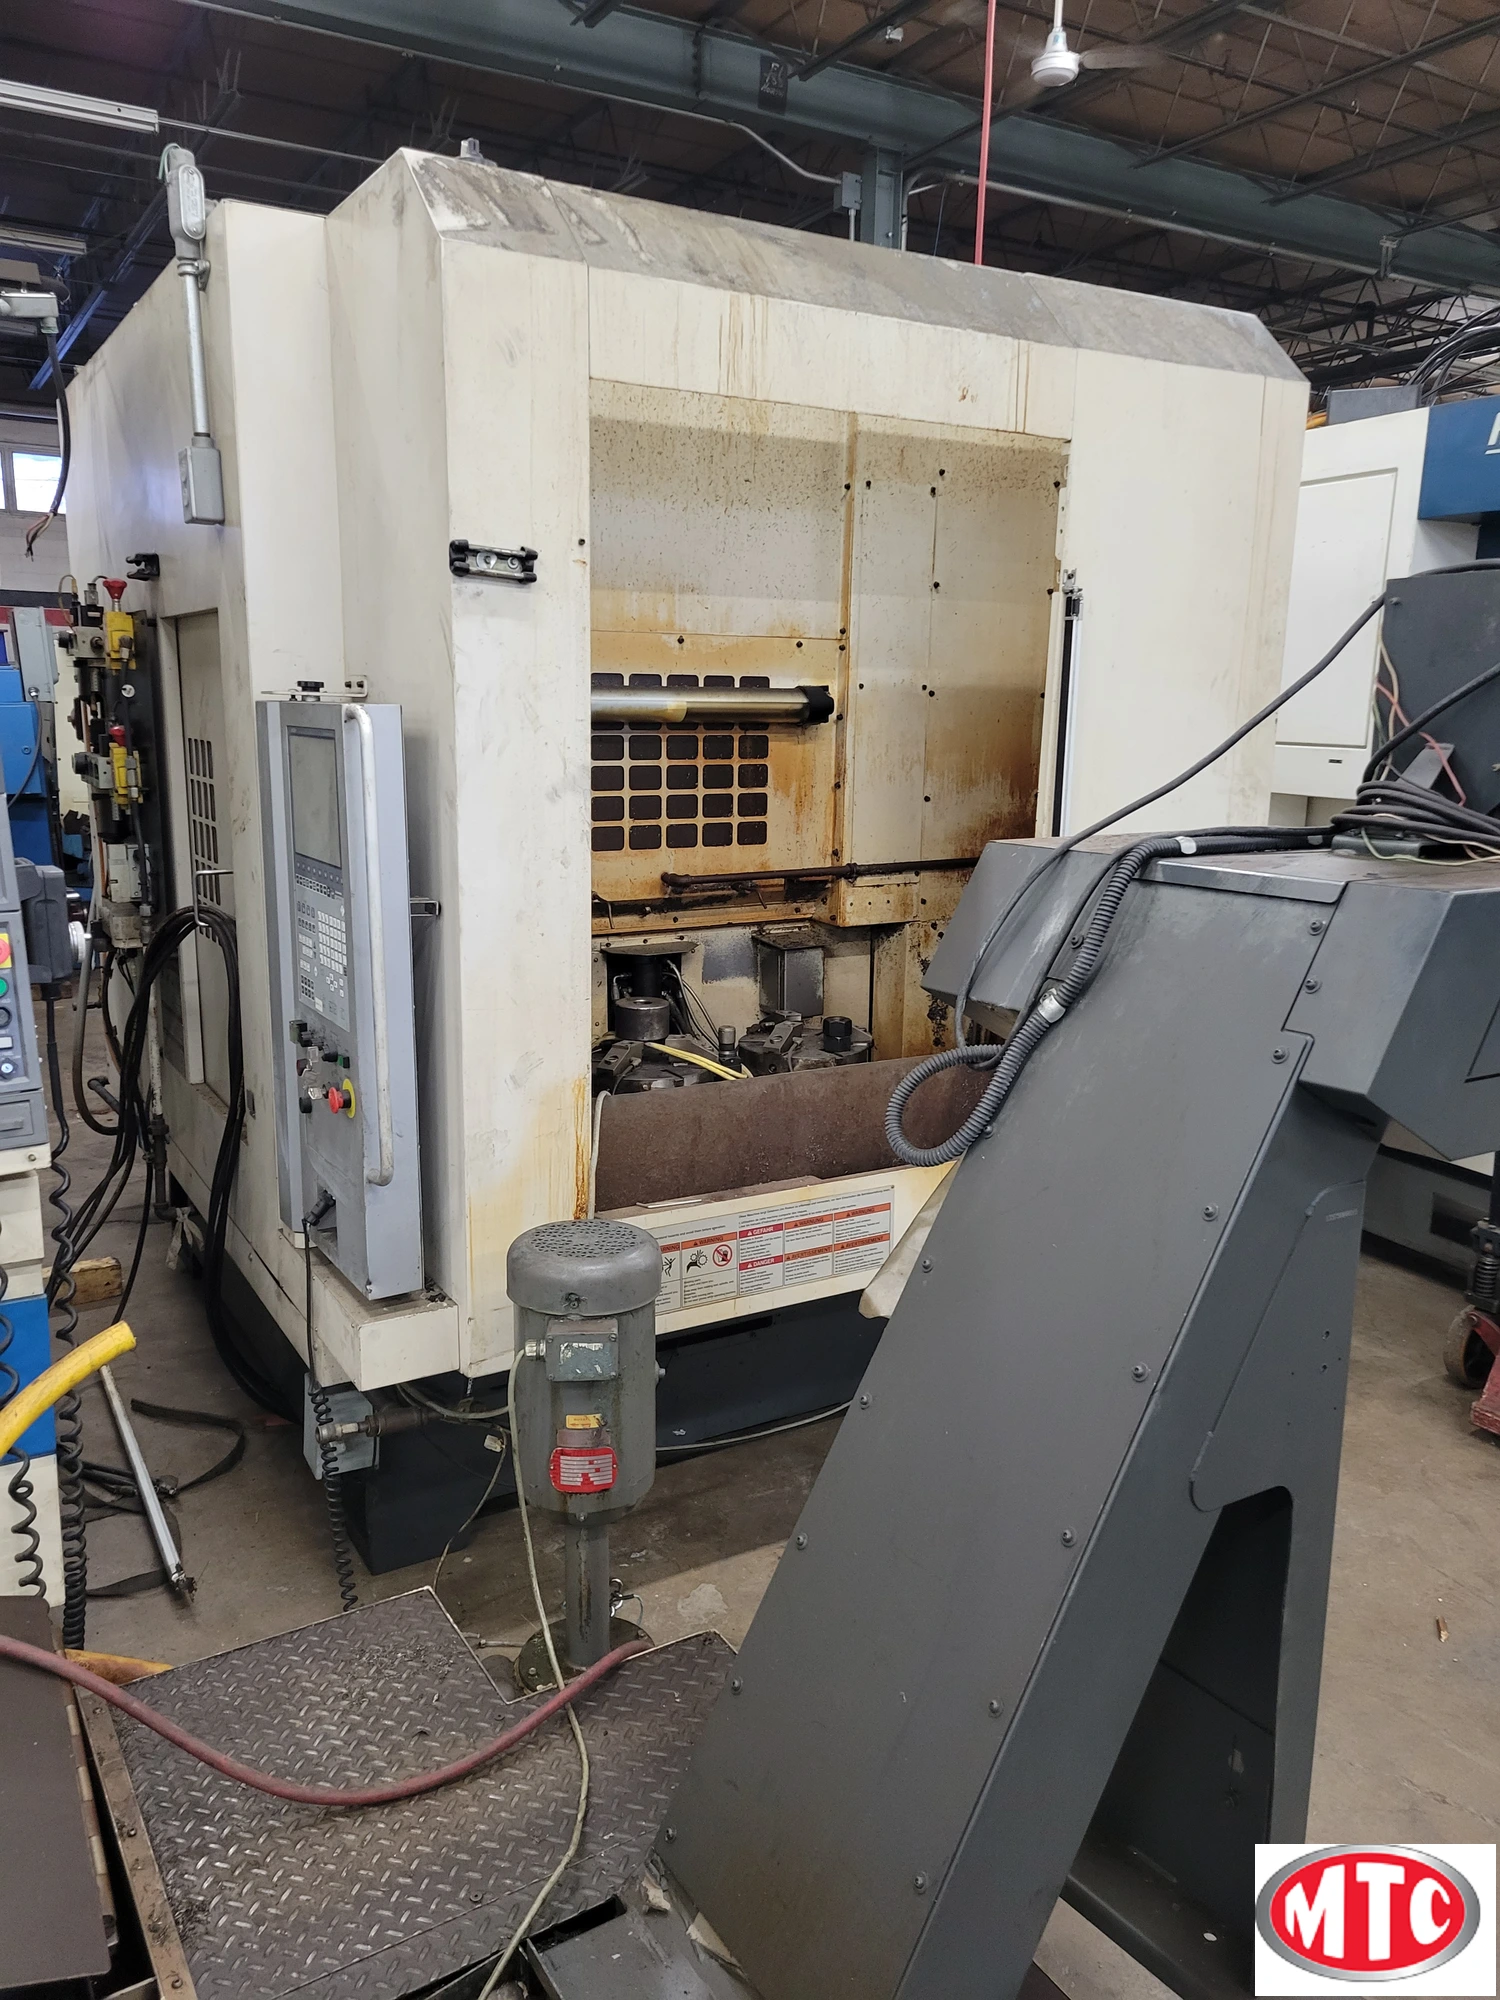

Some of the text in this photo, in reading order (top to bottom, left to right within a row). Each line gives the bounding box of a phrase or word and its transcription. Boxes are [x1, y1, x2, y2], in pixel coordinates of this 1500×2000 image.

[752, 1226, 774, 1235] GEFAHR
[699, 1235, 724, 1245] WARNING
[753, 1258, 775, 1267] DANGER
